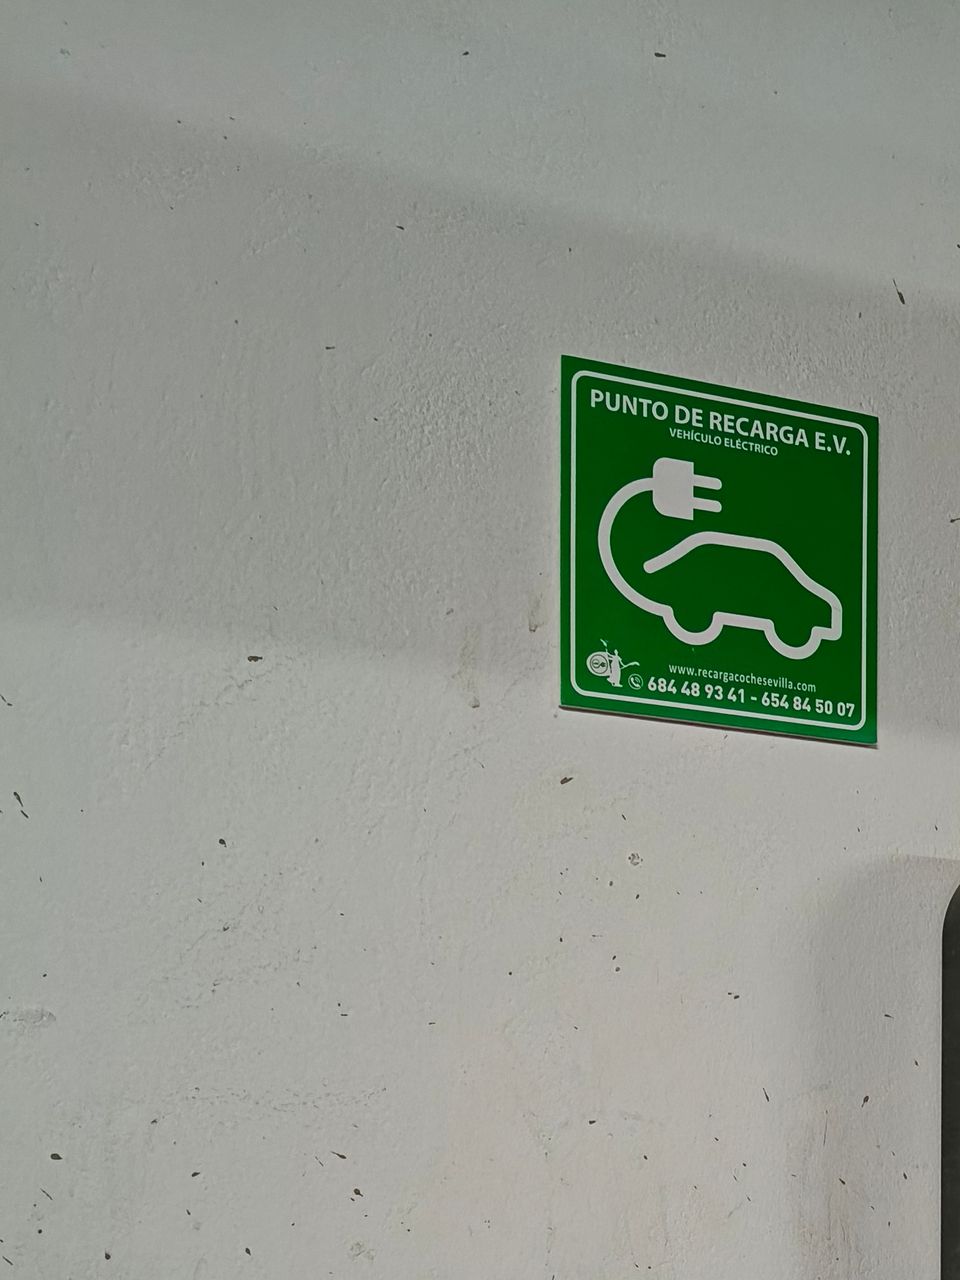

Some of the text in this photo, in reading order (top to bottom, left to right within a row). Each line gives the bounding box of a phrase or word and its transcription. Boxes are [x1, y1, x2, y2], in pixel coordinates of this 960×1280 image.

[590, 388, 851, 456] PUNTO DE RECARGA E.V.
[669, 427, 779, 456] VEHÍCULO ELÉCTRICO
[668, 664, 817, 693] www.recargacochesevilla.com
[647, 676, 678, 695] 684
[680, 680, 701, 697] 48
[704, 683, 724, 701] 93
[727, 687, 745, 704] 41
[761, 691, 790, 710] 654
[792, 695, 812, 712] 84
[815, 698, 833, 715] 50
[836, 701, 855, 718] 07
